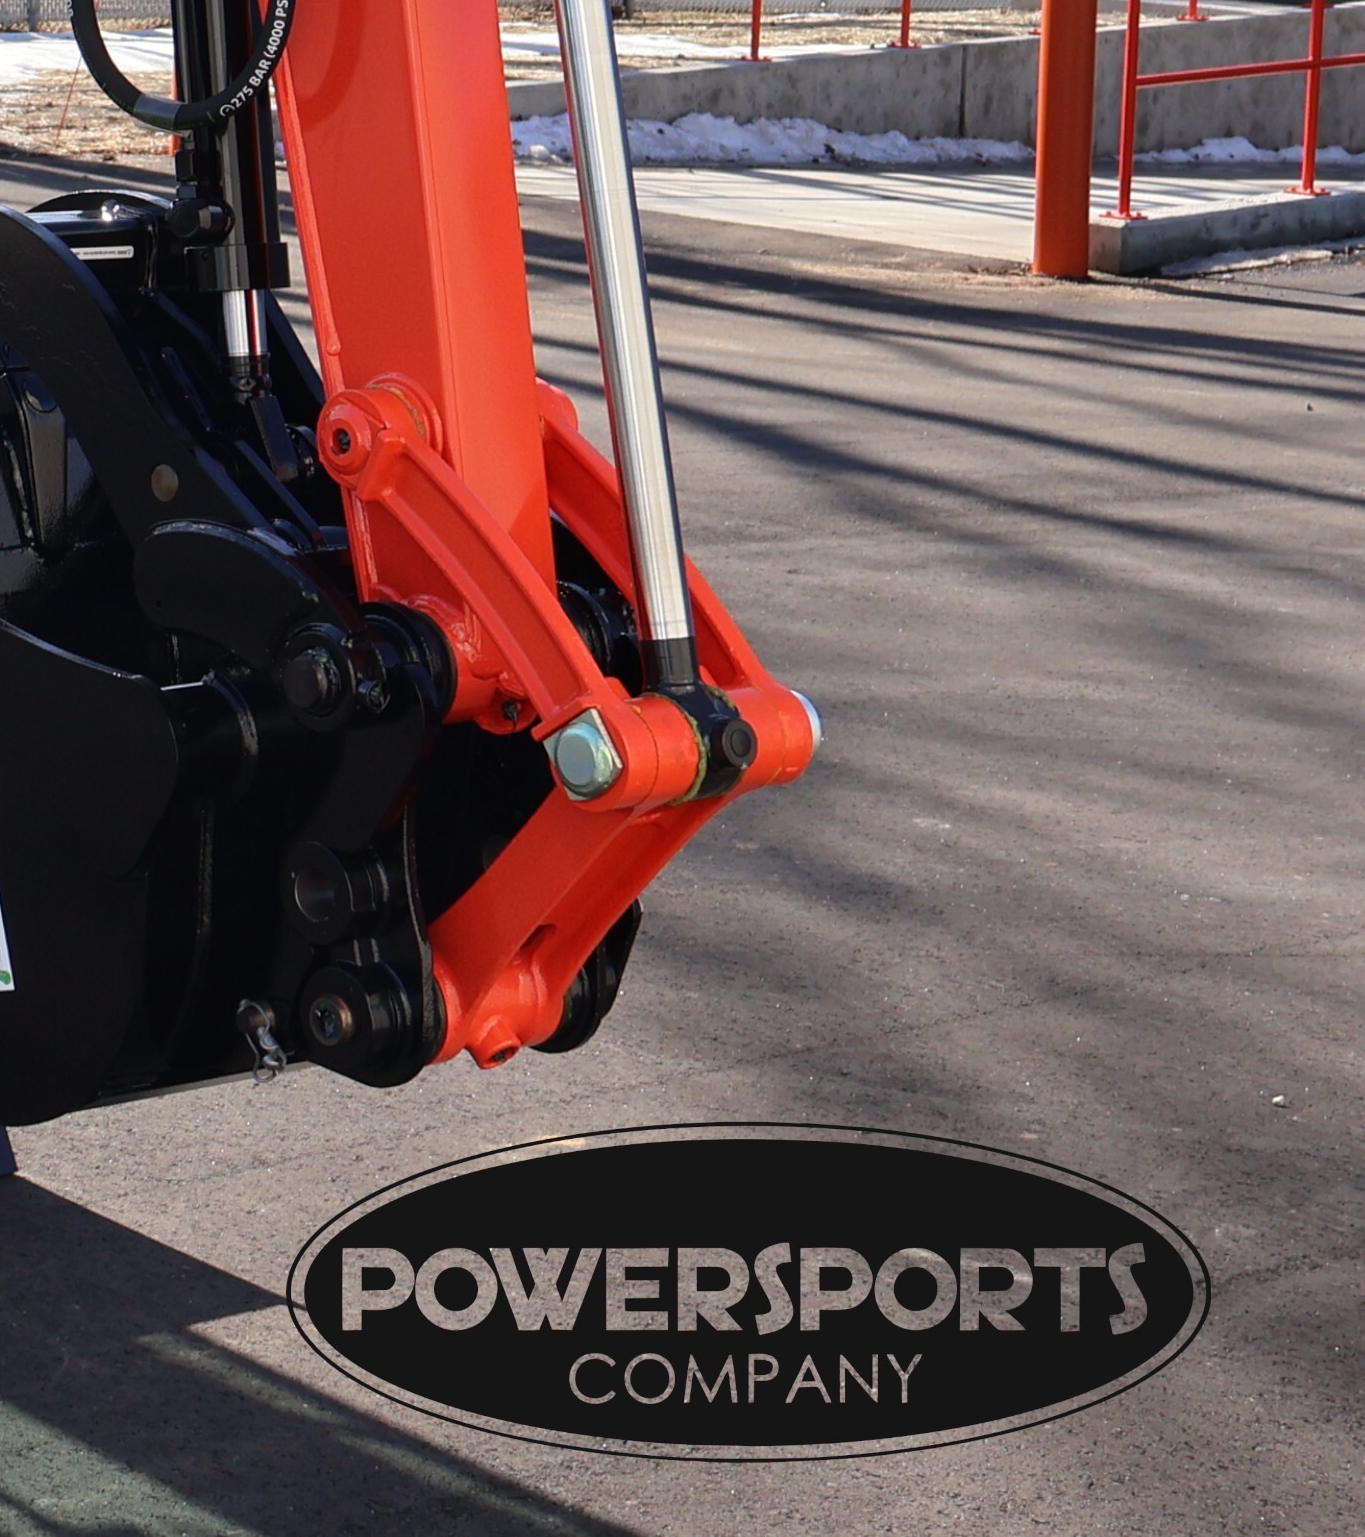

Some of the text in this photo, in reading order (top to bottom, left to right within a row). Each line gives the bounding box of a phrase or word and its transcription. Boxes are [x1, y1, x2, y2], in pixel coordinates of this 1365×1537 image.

[230, 85, 254, 109] 275
[249, 59, 272, 87] BAR
[263, 20, 286, 59] (4000
